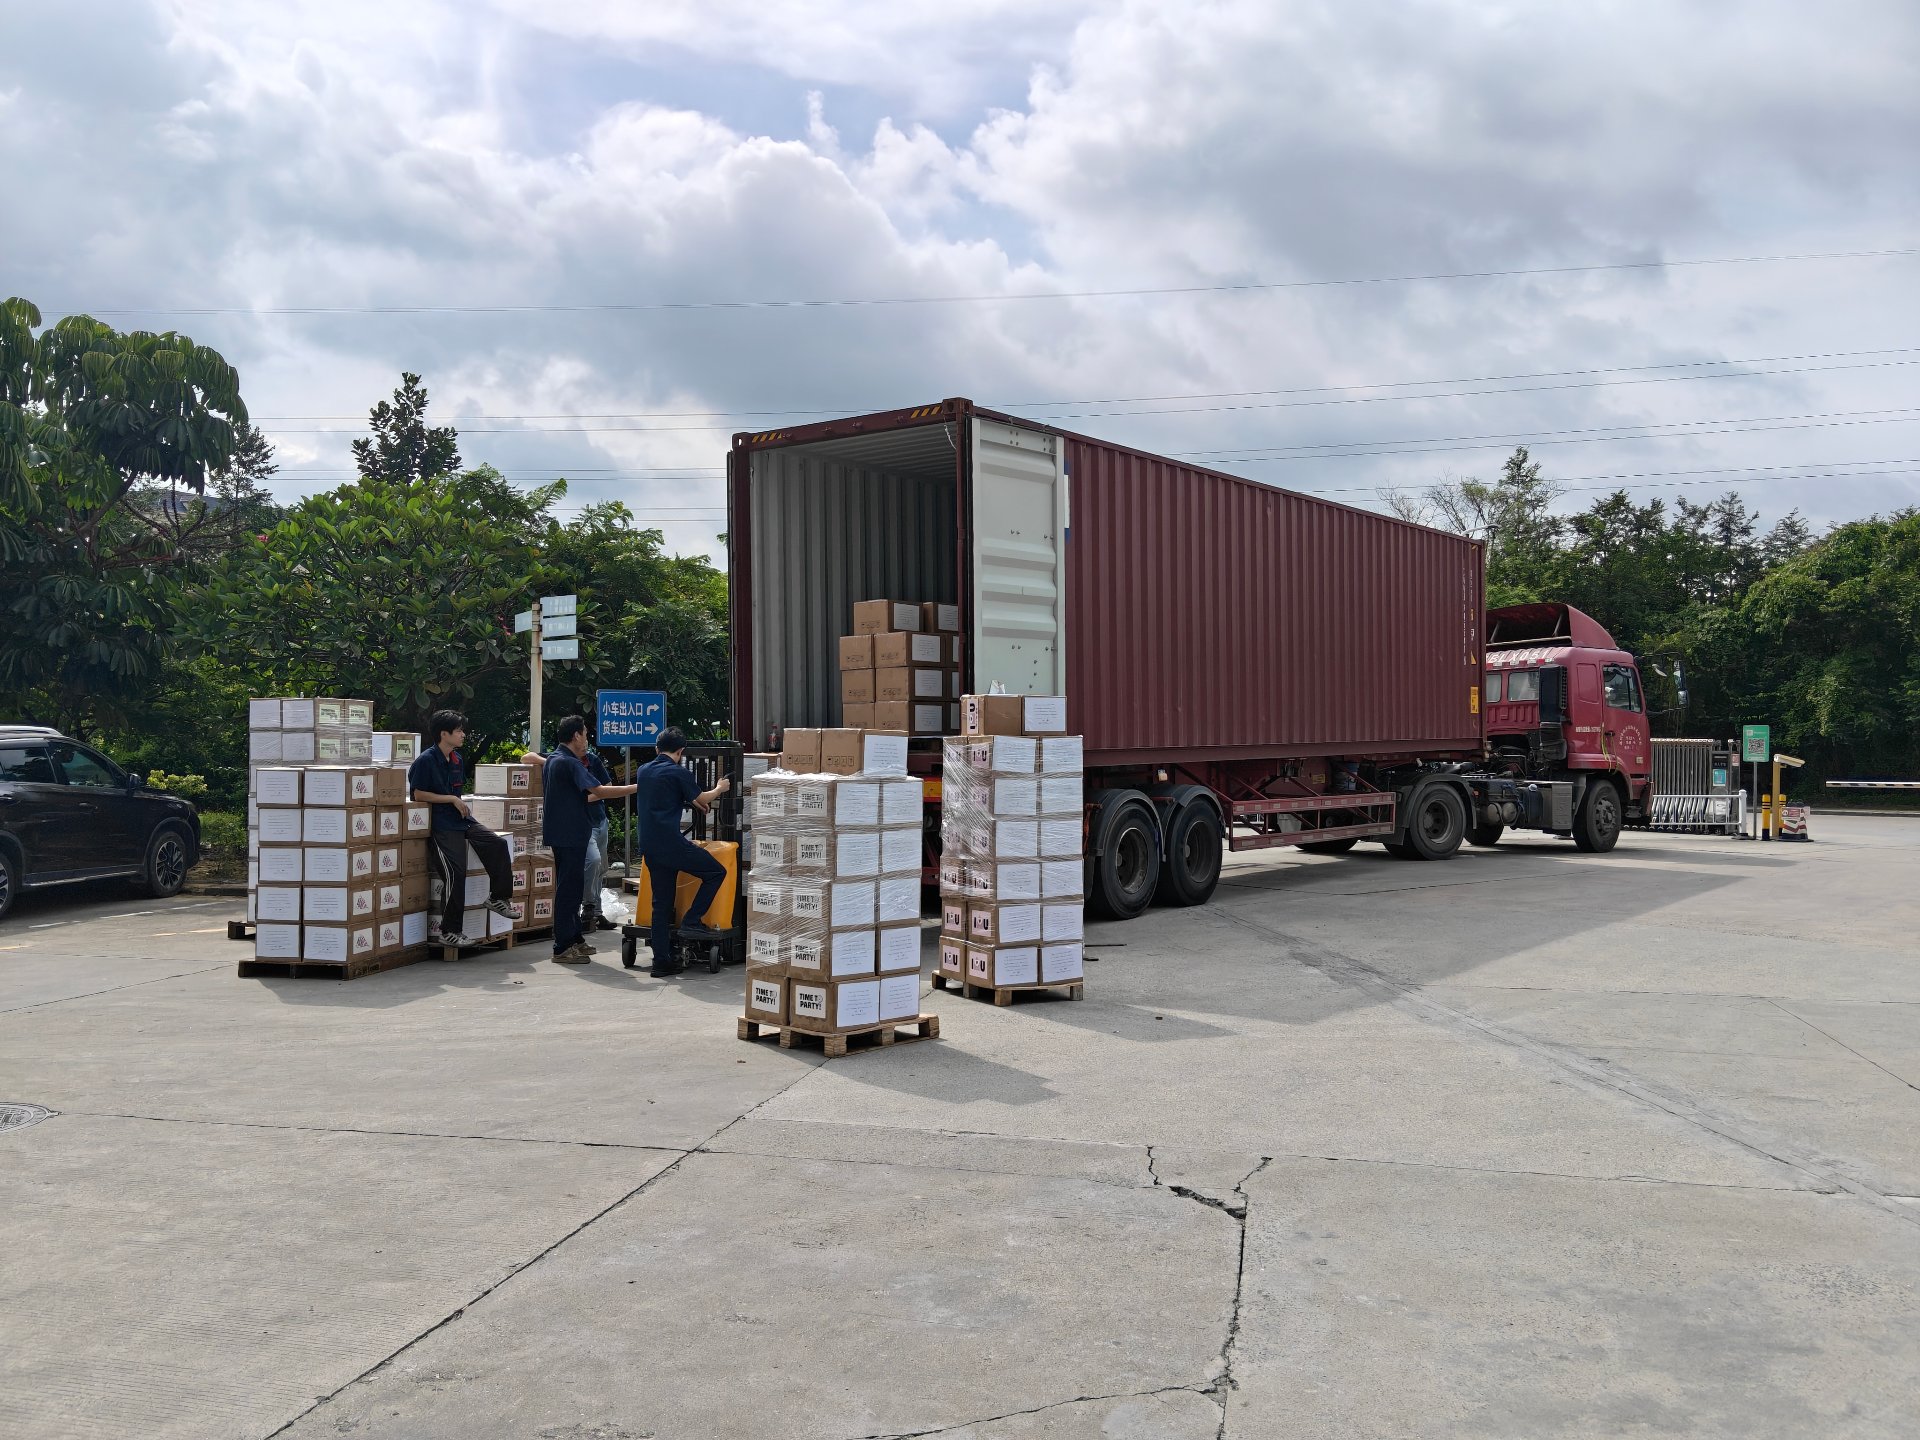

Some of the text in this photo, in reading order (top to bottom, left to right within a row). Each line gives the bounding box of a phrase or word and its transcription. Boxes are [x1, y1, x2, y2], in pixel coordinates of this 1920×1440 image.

[603, 700, 643, 716] 小车出入口
[603, 720, 643, 735] 货车出入口
[801, 851, 822, 859] PARTY!
[795, 953, 816, 962] PARTY!
[755, 987, 769, 996] TIME
[755, 995, 776, 1005] PARTY!
[799, 993, 813, 1001] TIME
[799, 1001, 822, 1010] PARTY!
